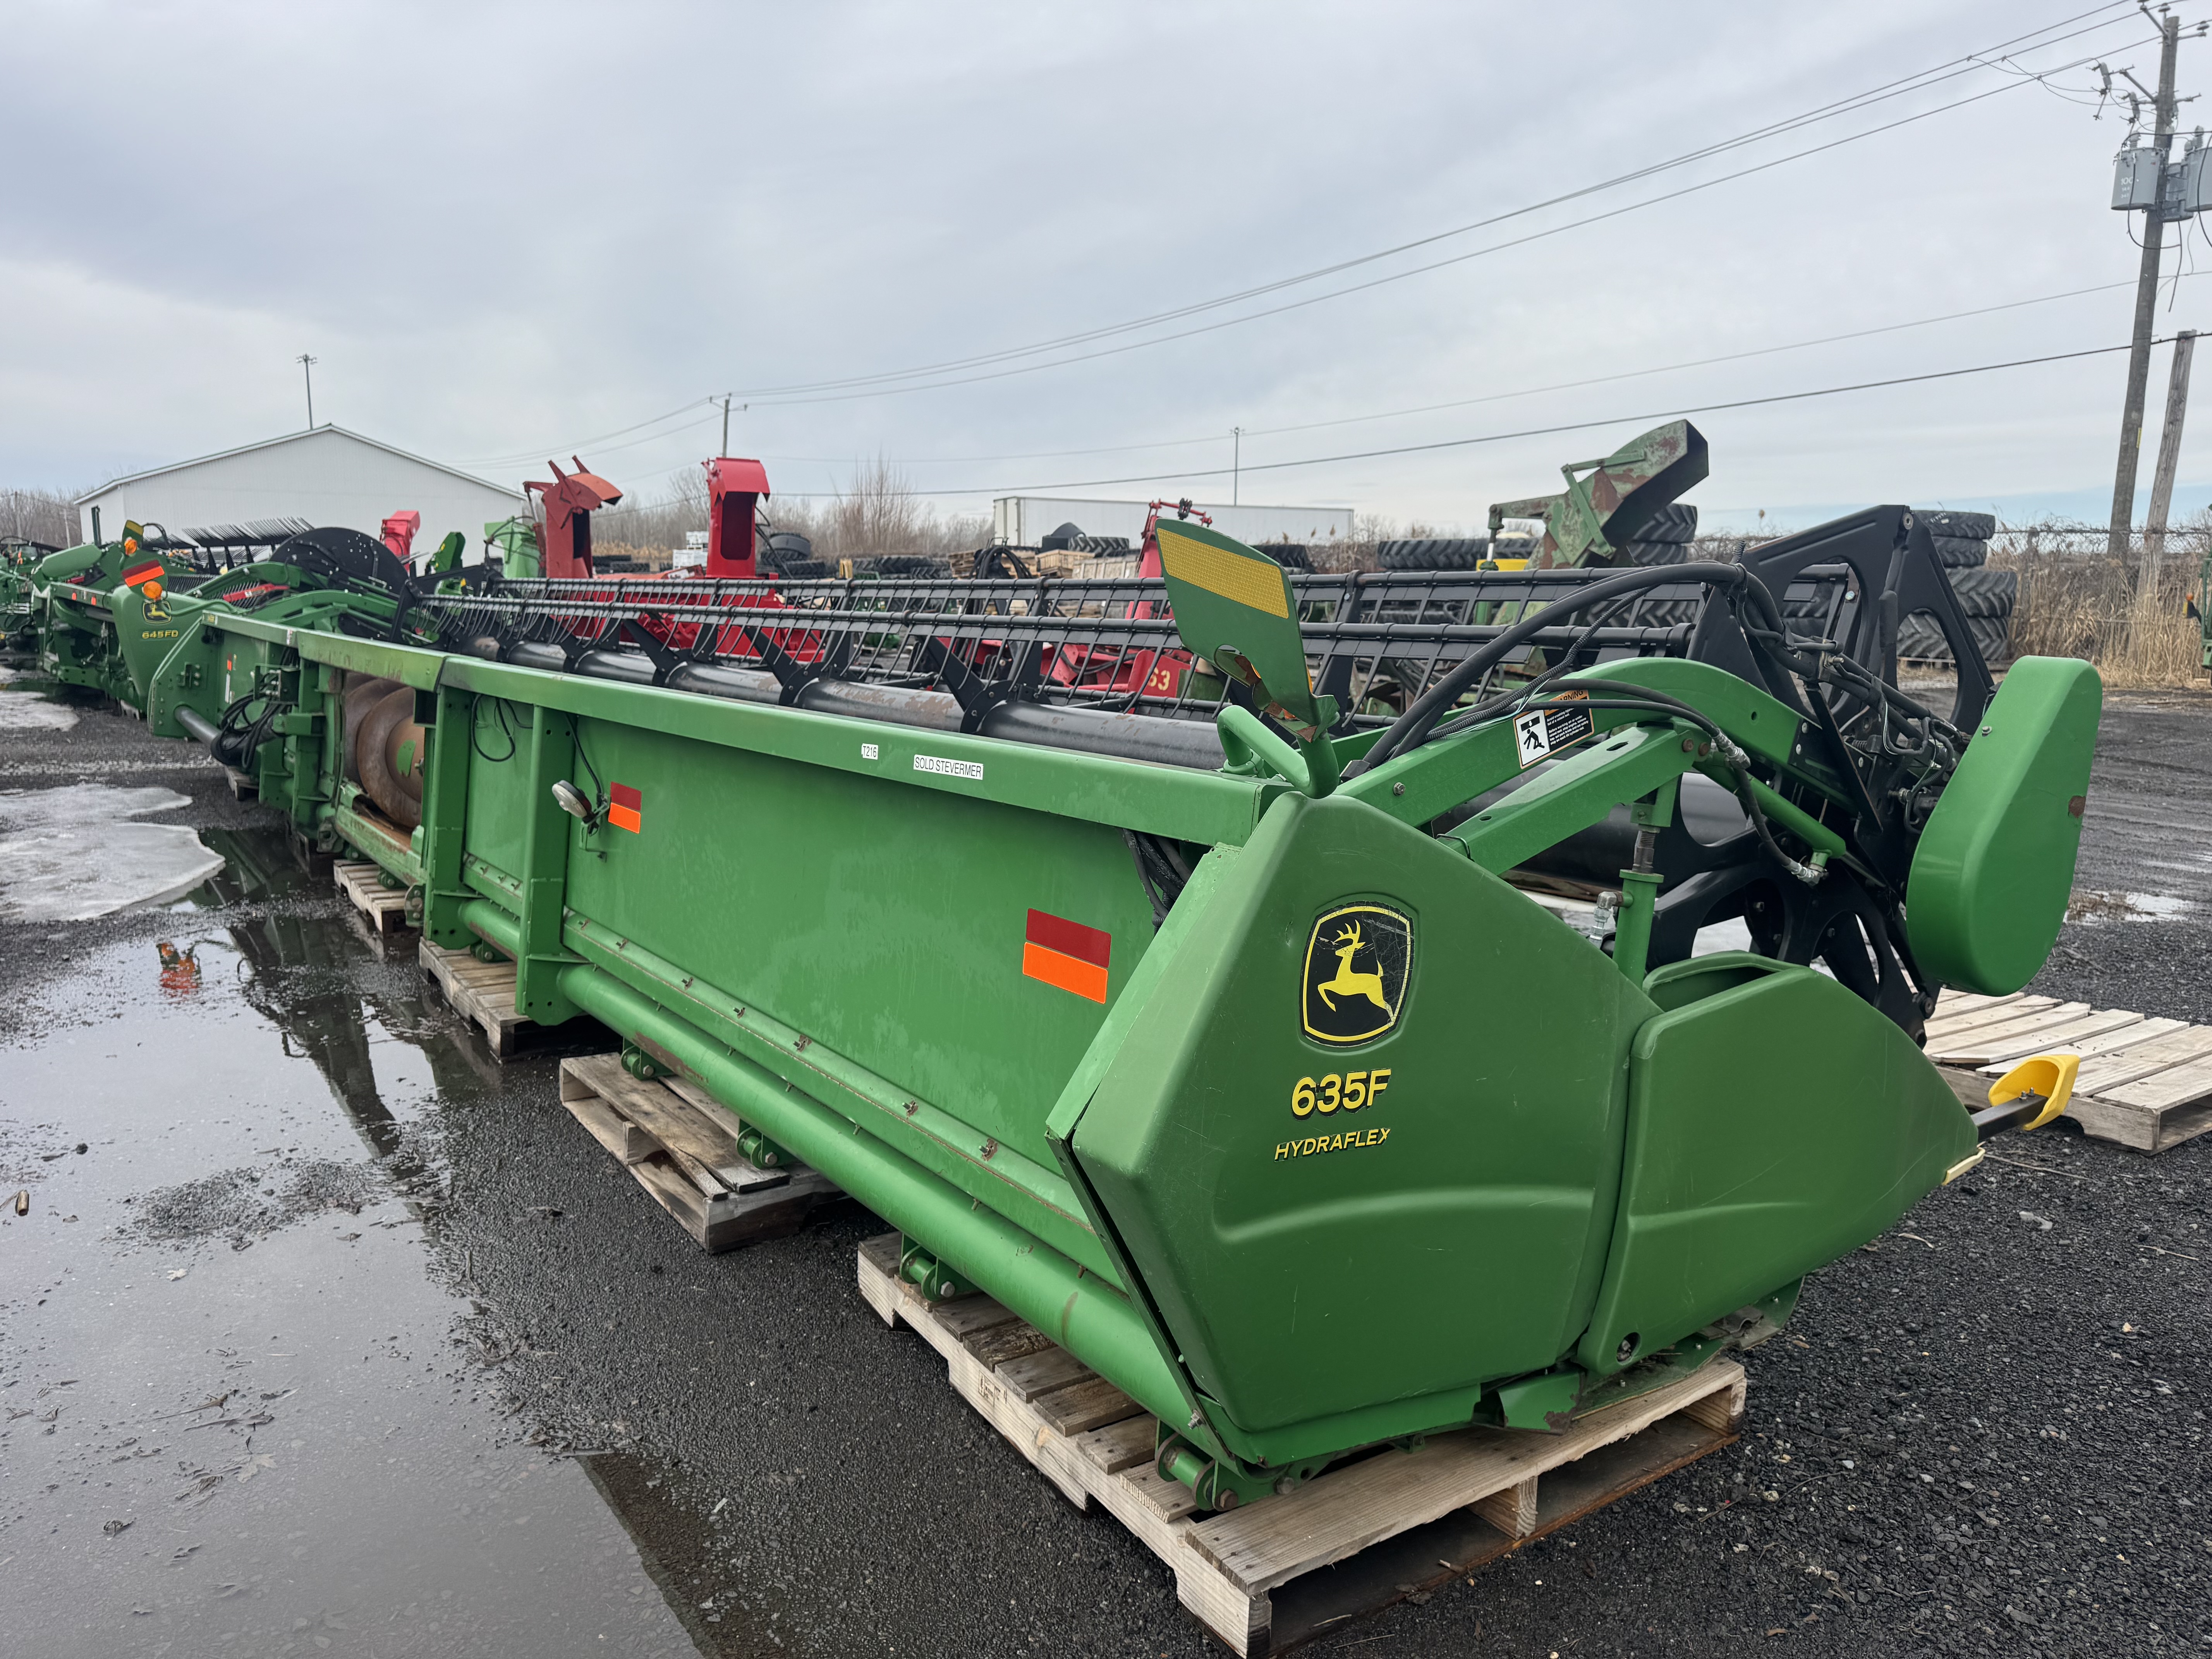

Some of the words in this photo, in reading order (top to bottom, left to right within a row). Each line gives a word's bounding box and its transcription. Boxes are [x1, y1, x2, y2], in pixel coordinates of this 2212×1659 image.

[142, 630, 178, 639] 645FD
[863, 746, 876, 757] T216
[915, 757, 934, 770] SOLD
[936, 760, 981, 777] STEVERMER
[1291, 1068, 1391, 1117] 635F
[1274, 1128, 1391, 1162] HYDRAFLEX
